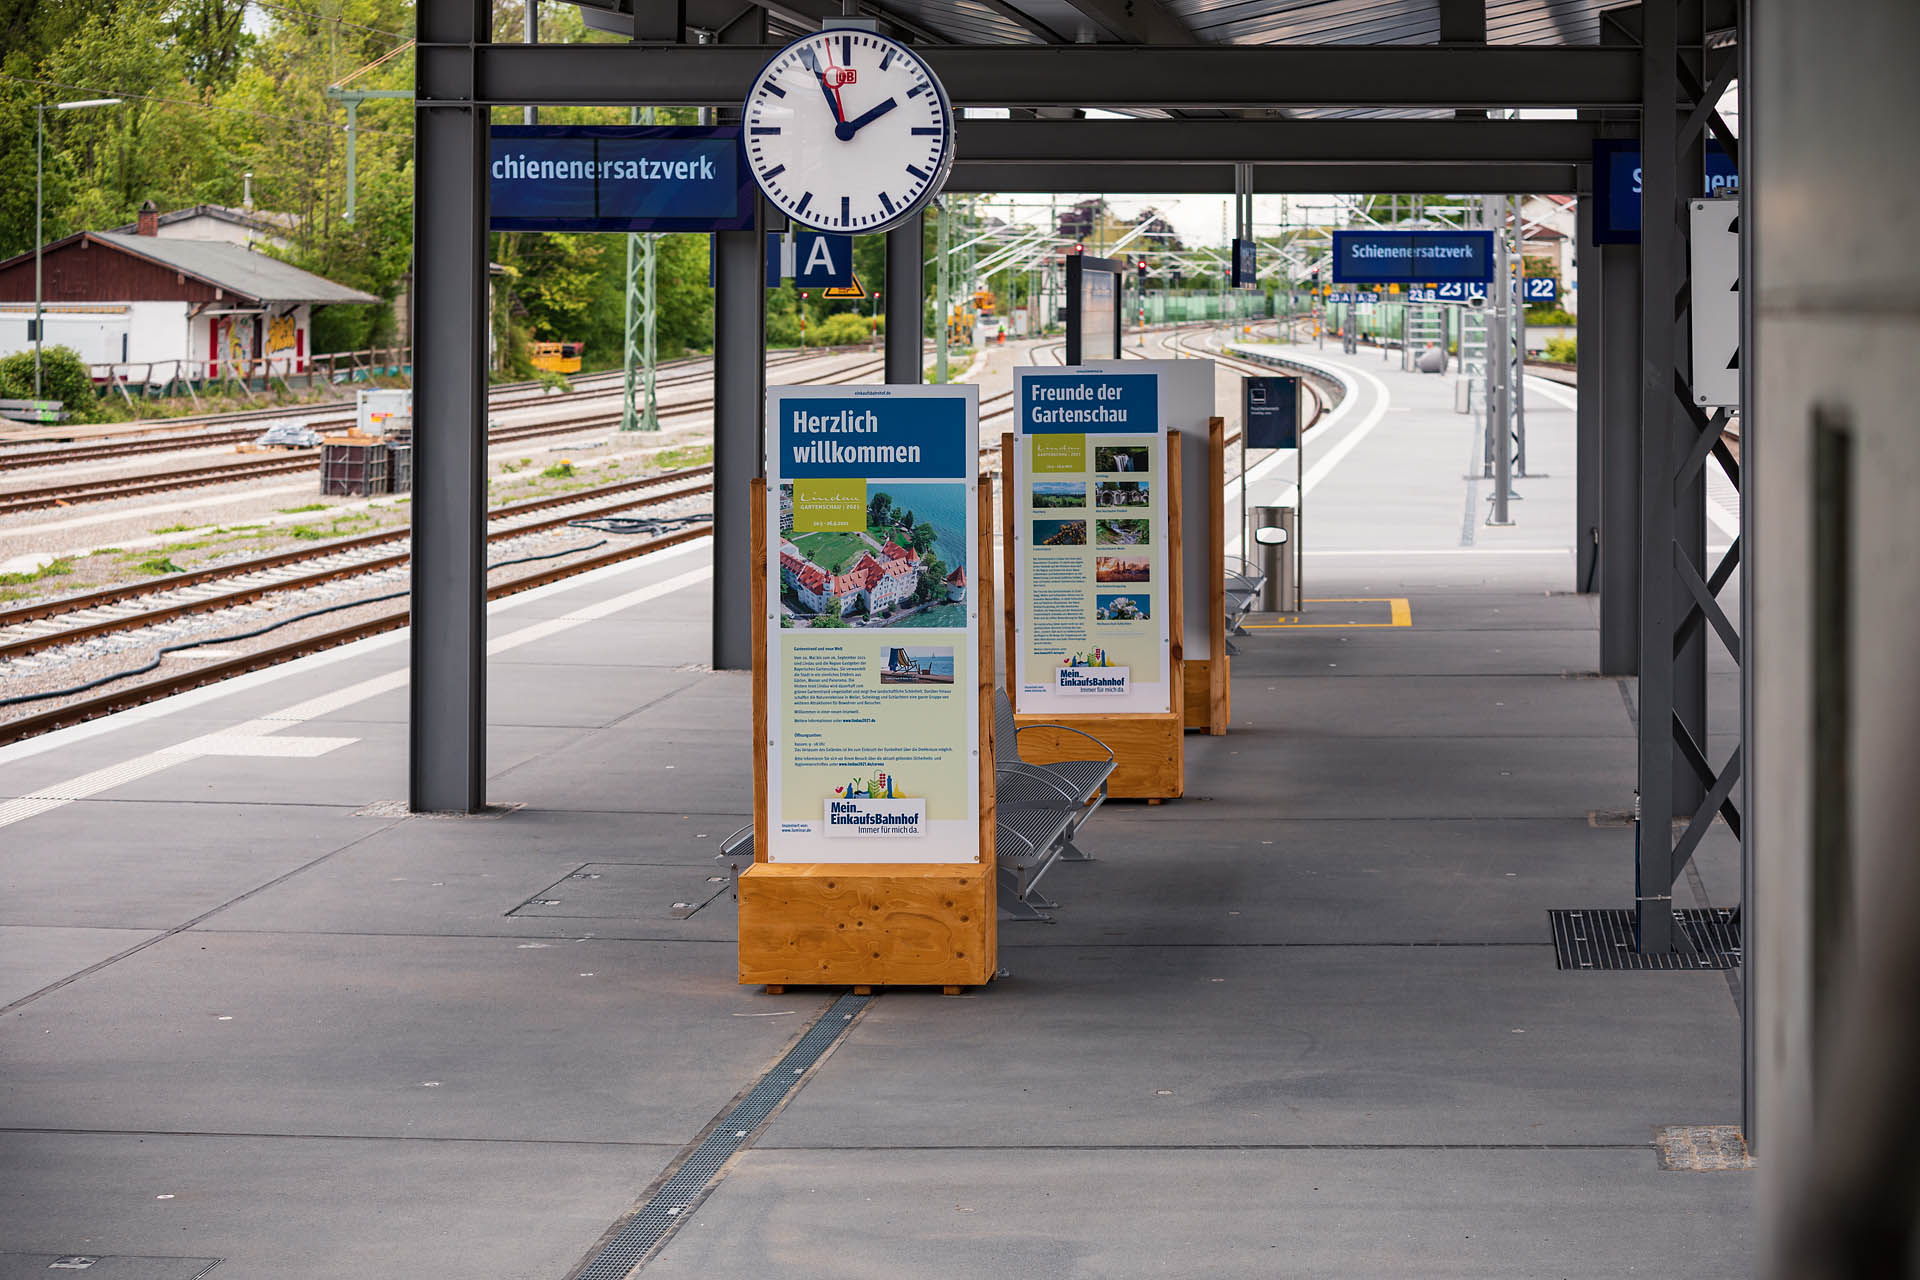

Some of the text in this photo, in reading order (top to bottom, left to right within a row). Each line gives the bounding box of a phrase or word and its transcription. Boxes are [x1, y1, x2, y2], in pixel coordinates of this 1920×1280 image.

[490, 154, 715, 180] chienenersatzverk
[803, 236, 836, 275] A
[1352, 244, 1473, 258] Schienenersatzverk
[1409, 289, 1423, 300] 23
[1440, 282, 1484, 296] 23 C
[1531, 279, 1554, 297] 22
[1032, 384, 1123, 401] Freunde der
[793, 410, 878, 433] Herzlich
[1032, 406, 1128, 423] Gartenschau
[793, 441, 921, 463] willkommen
[1060, 677, 1125, 686] EinkaufsBahnhof
[831, 813, 918, 824] EinkaufsBahnhof
